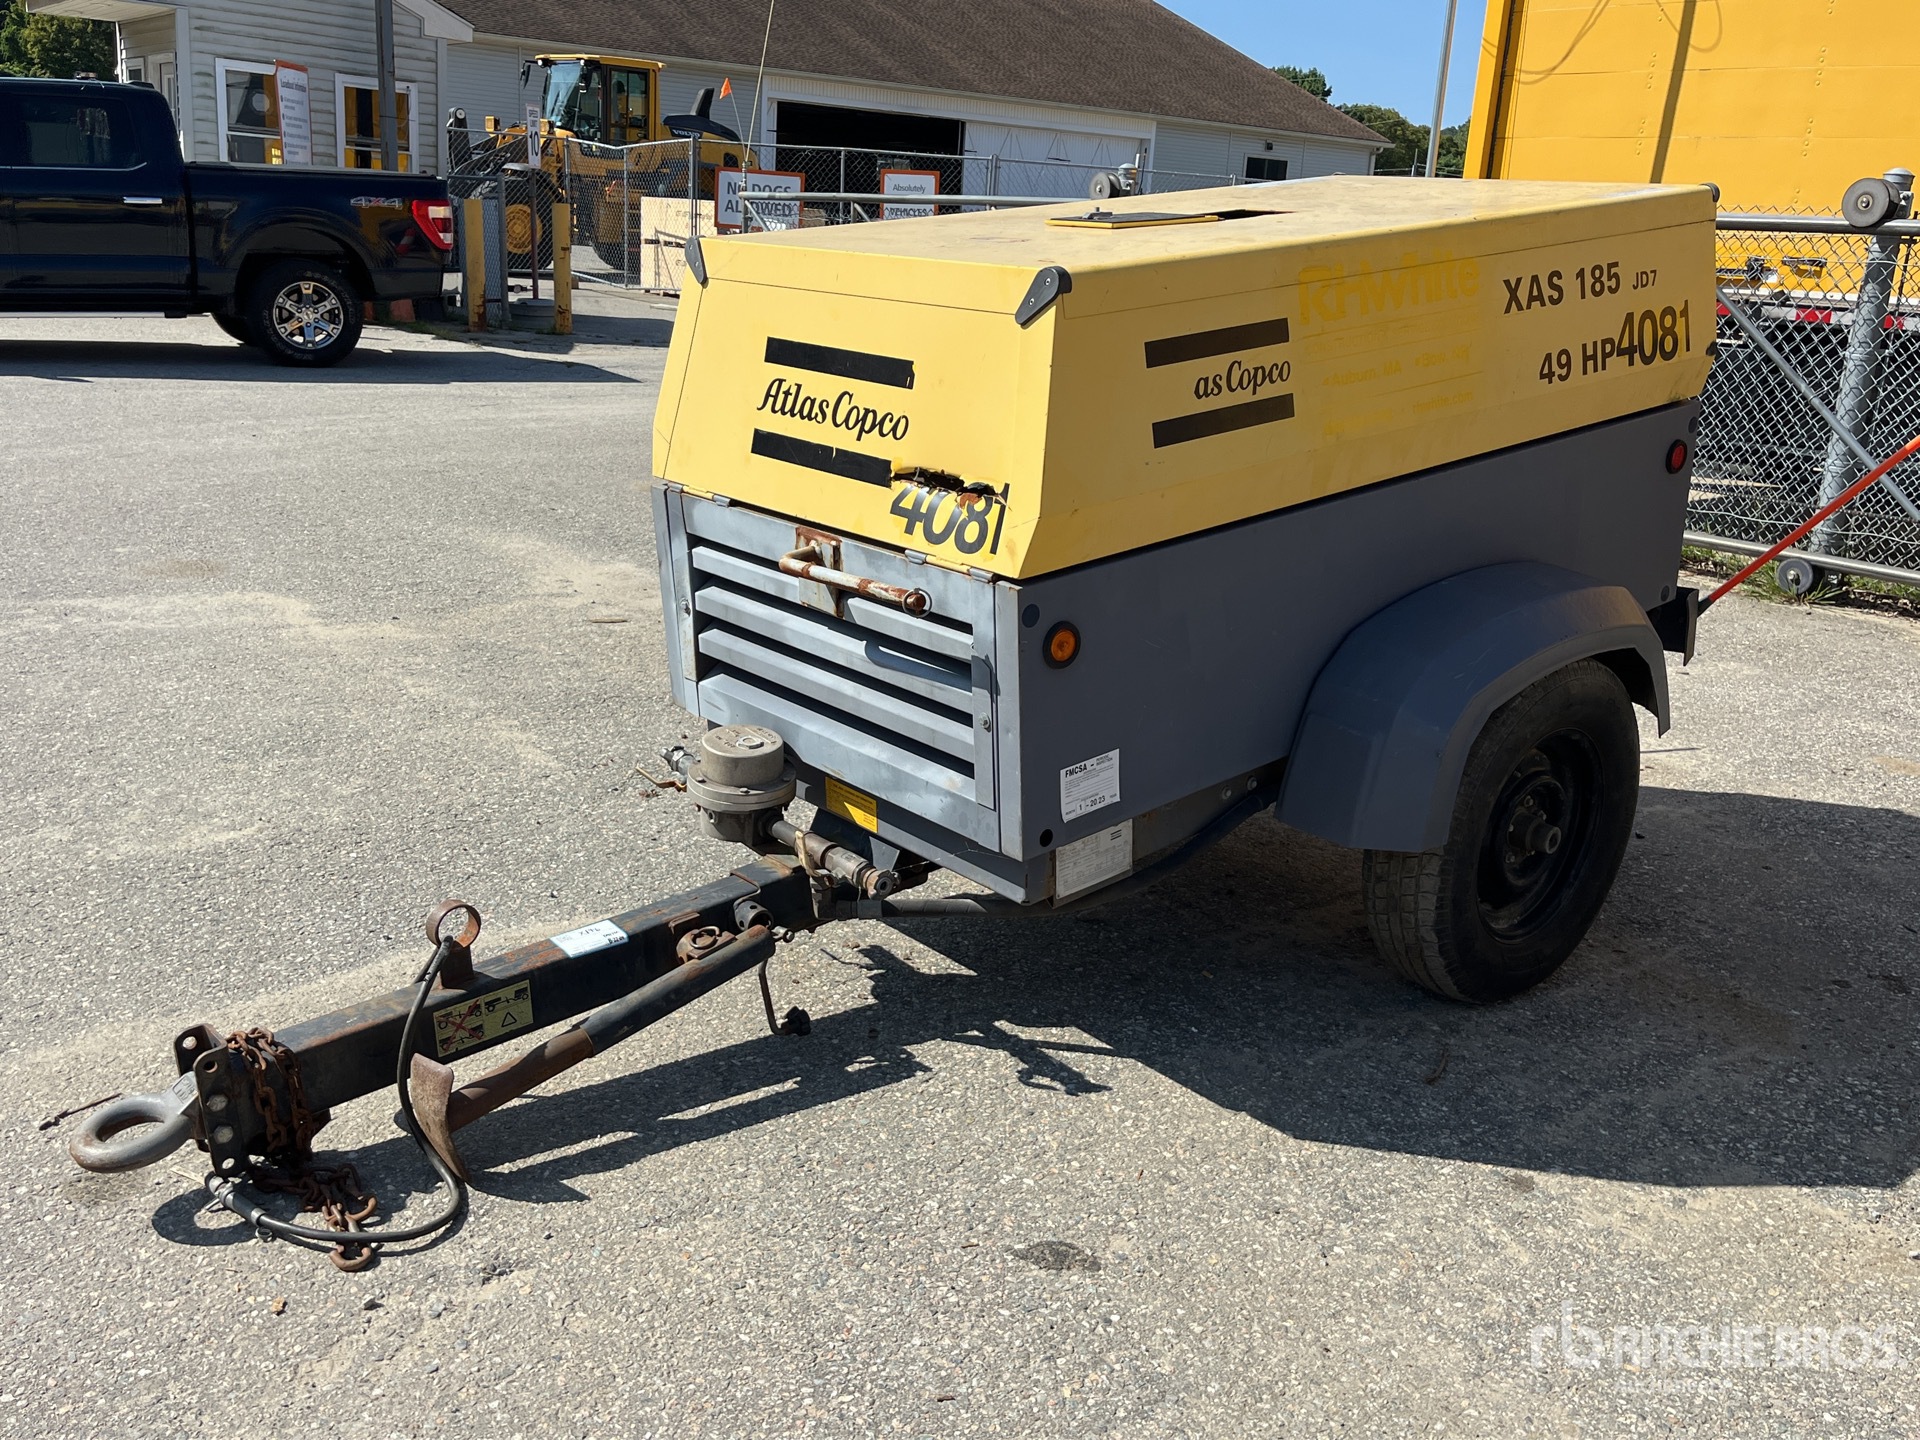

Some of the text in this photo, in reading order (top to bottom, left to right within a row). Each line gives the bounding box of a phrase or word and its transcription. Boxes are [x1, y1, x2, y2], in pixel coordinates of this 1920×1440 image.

[529, 130, 540, 156] 10
[672, 128, 700, 139] VOLVO
[892, 183, 926, 194] Absolutely
[1502, 261, 1657, 315] XAS 185 JD7
[1616, 299, 1691, 367] 4081
[1226, 360, 1291, 396] Copco
[1538, 336, 1616, 385] 49 HP
[757, 378, 909, 442] Atlas Copco
[890, 482, 1010, 556] 4081
[1065, 763, 1088, 778] FMCSA
